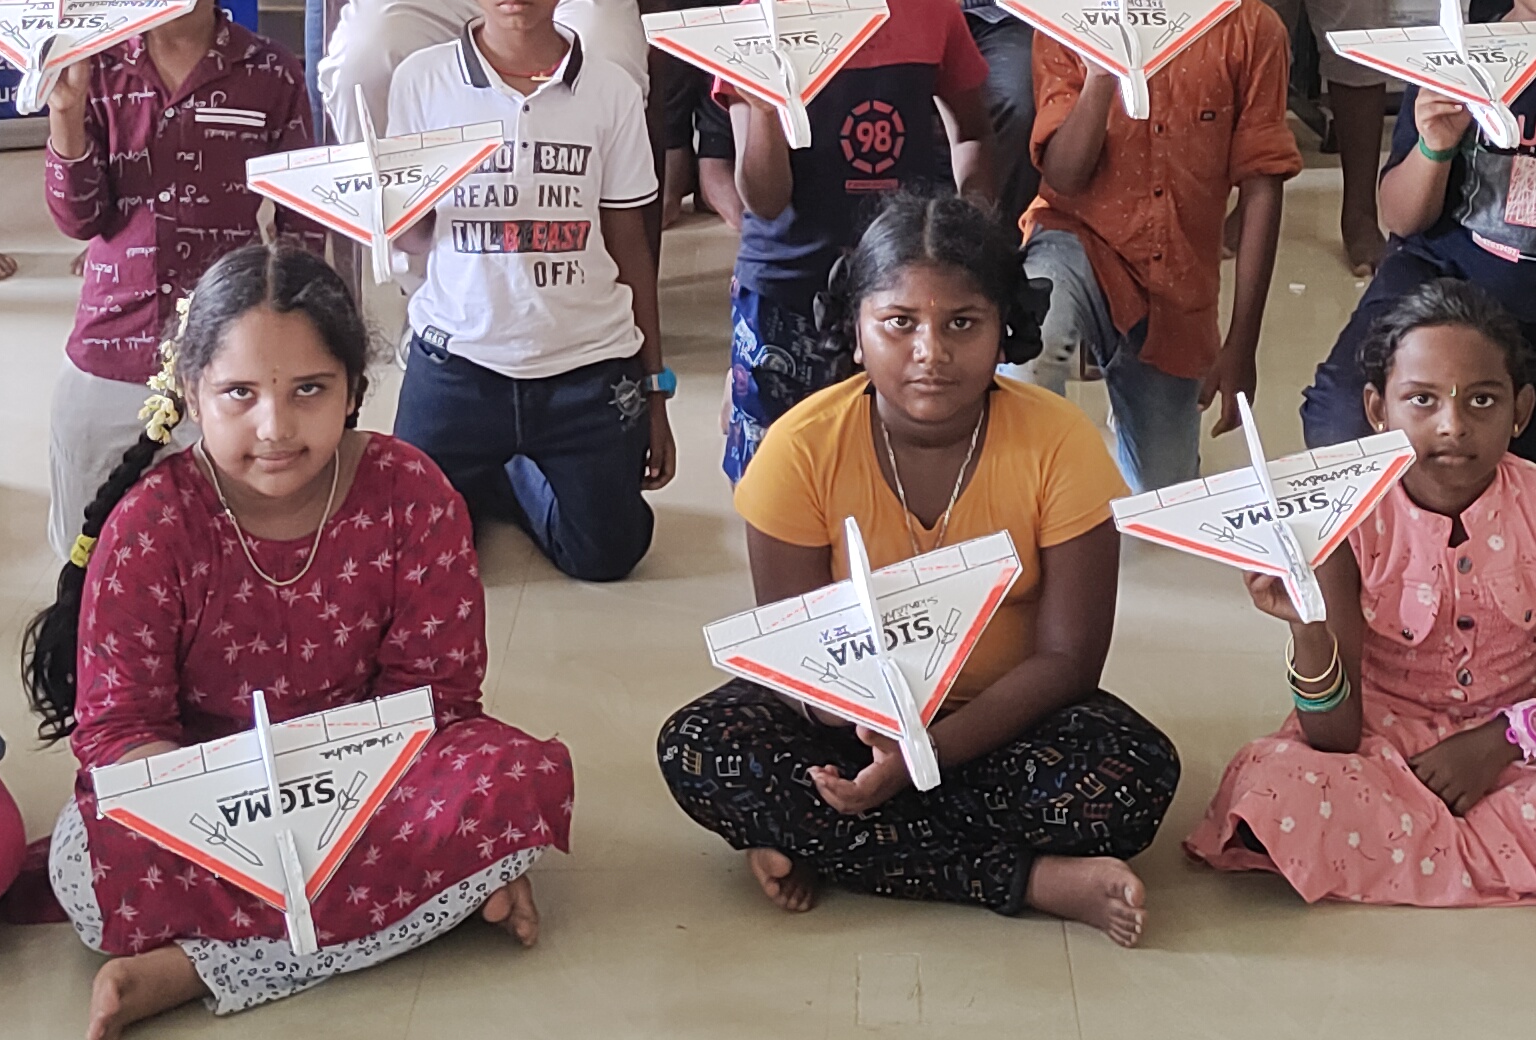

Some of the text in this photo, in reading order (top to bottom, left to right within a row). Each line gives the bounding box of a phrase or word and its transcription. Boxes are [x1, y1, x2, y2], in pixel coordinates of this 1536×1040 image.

[22, 16, 104, 30] SIGMA
[856, 120, 893, 153] 98
[540, 145, 585, 173] BAN
[453, 184, 520, 208] READ
[1225, 492, 1330, 530] SIGMA
[218, 777, 336, 828] SIGMA
